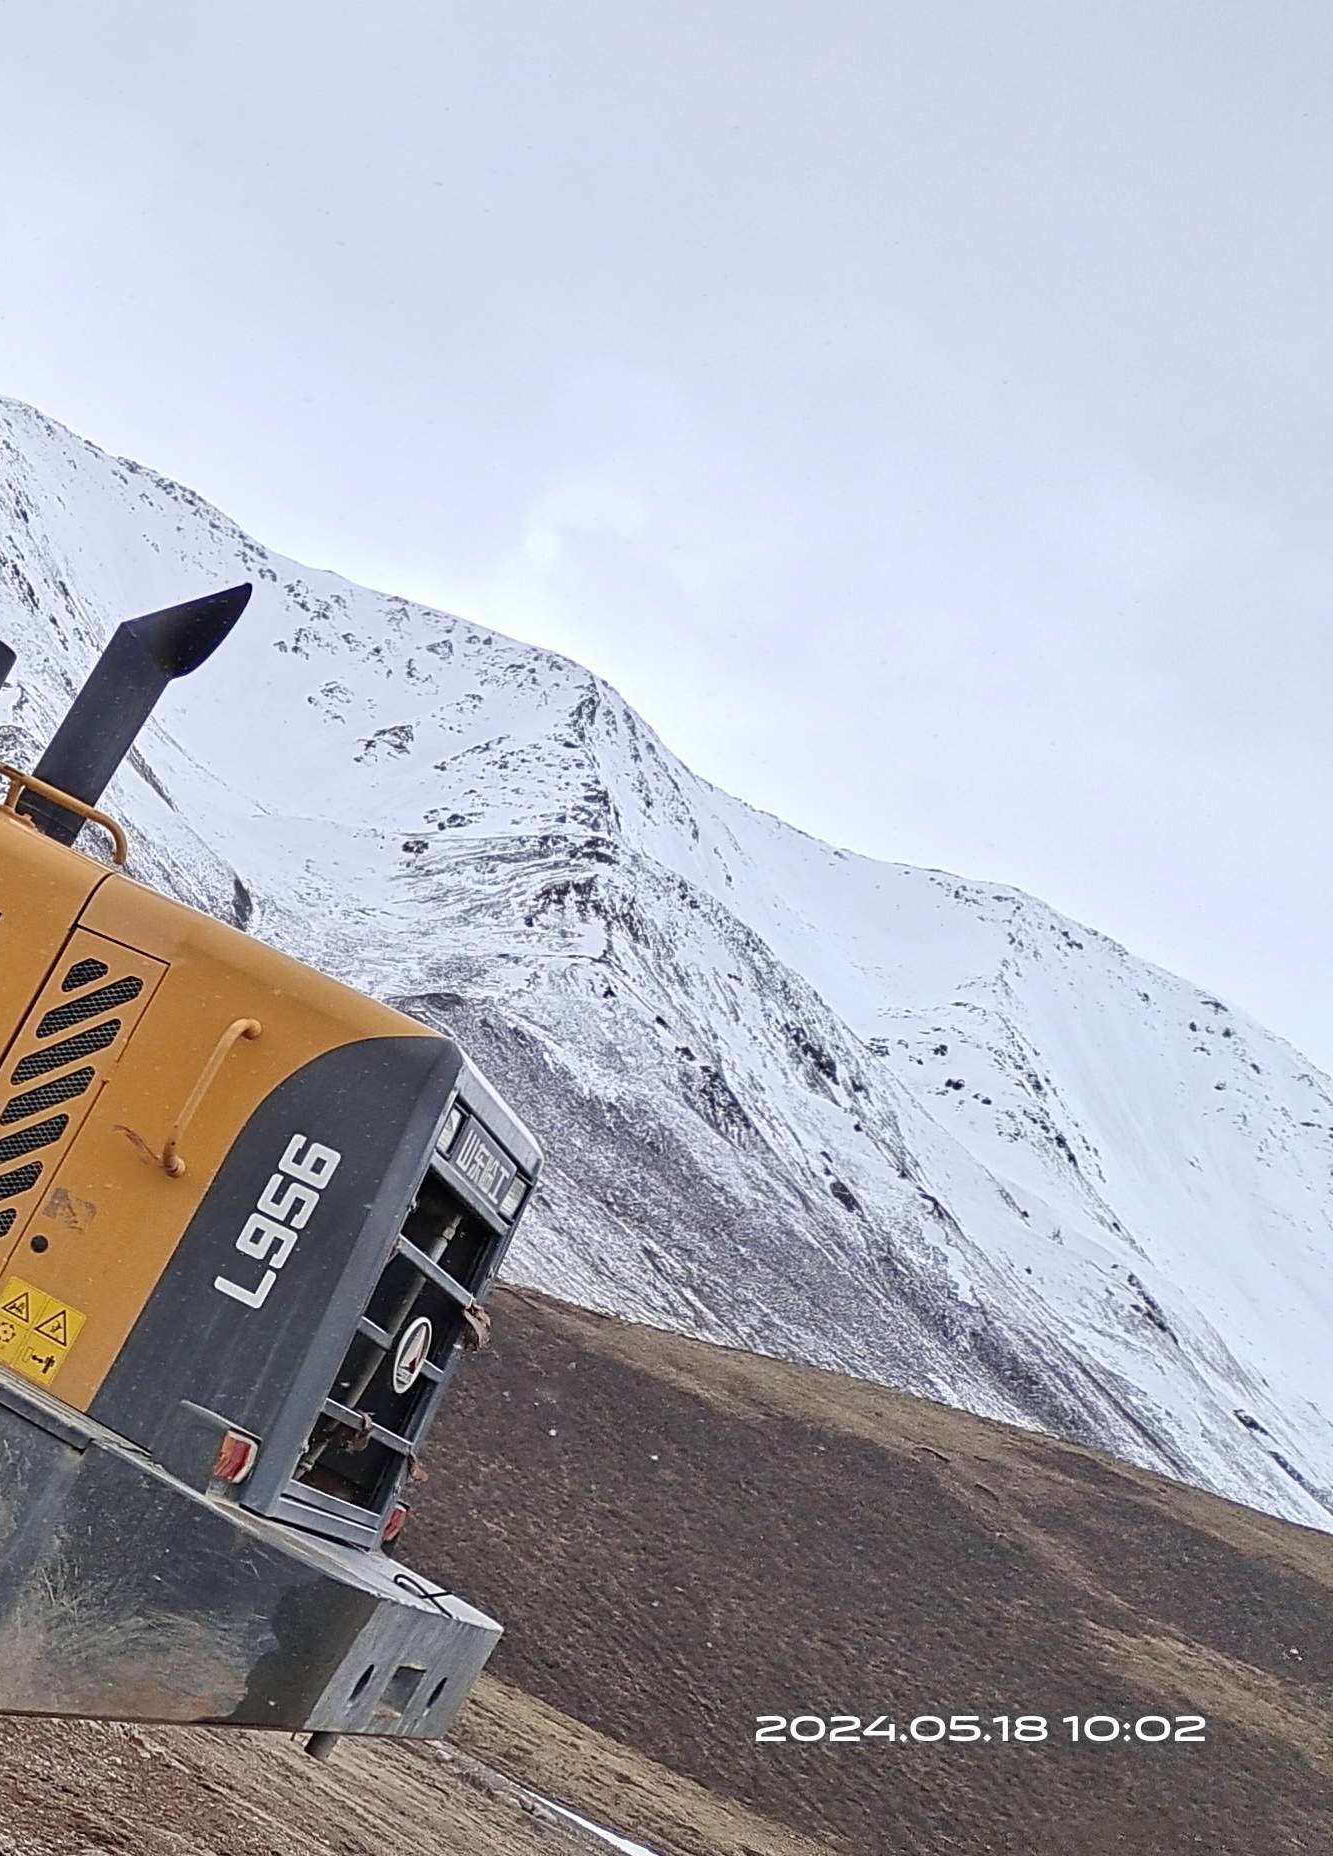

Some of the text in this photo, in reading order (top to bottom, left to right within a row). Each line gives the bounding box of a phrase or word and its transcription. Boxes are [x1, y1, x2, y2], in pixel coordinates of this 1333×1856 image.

[213, 1133, 342, 1310] L956
[455, 1128, 512, 1205] 山东临工
